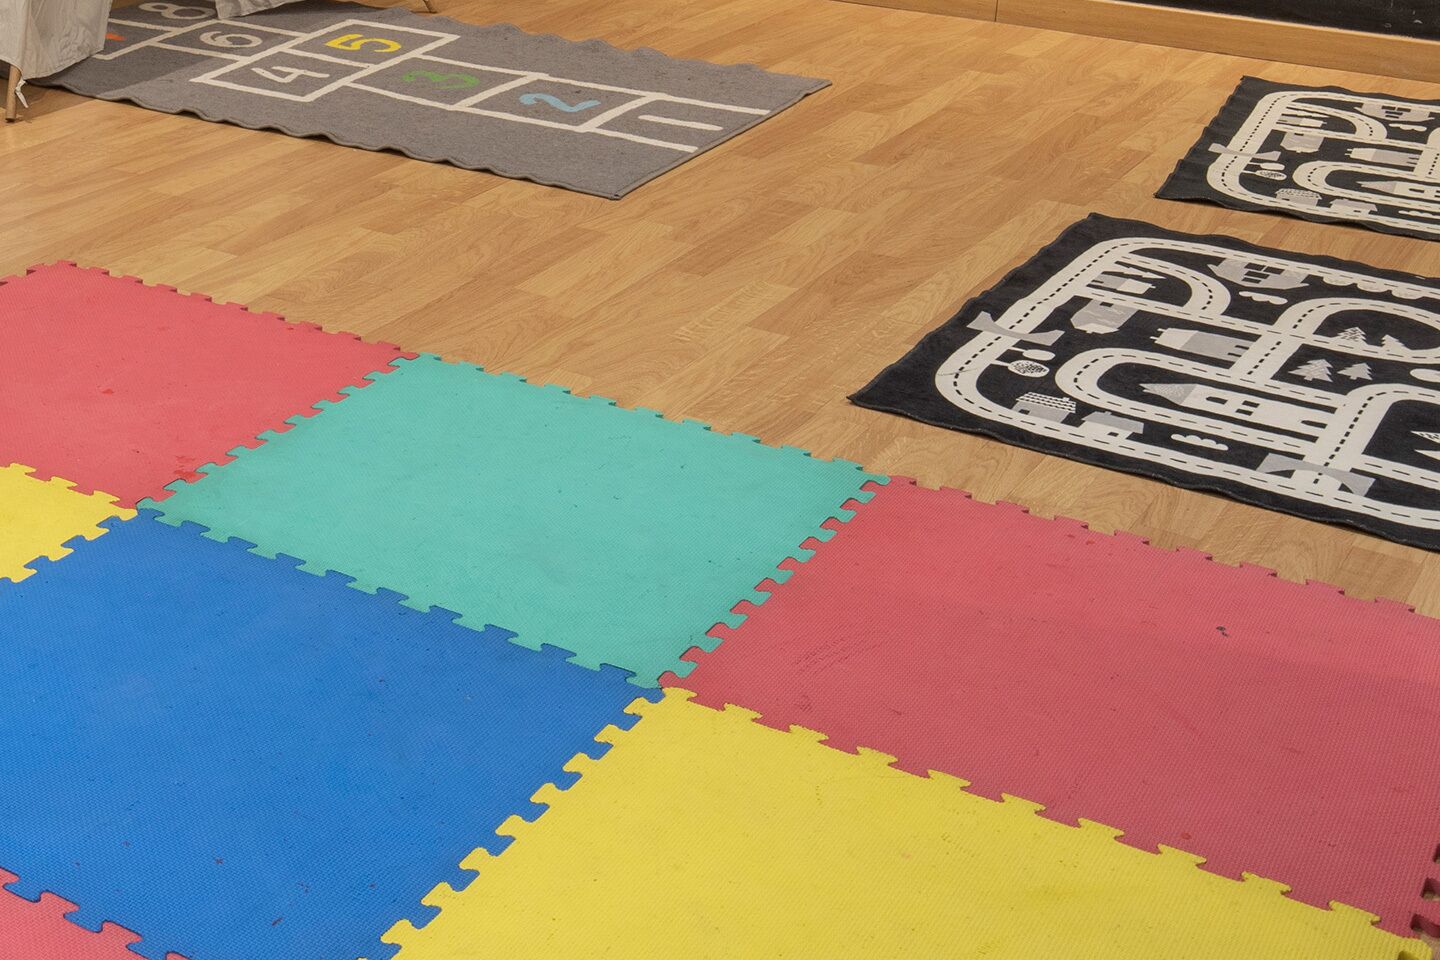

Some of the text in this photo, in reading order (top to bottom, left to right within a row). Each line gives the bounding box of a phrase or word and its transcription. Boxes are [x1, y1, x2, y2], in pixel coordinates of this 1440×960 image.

[200, 31, 263, 48] 6
[325, 33, 402, 53] 5
[251, 65, 330, 84] 4
[400, 69, 481, 90] 3
[519, 93, 602, 113] 2
